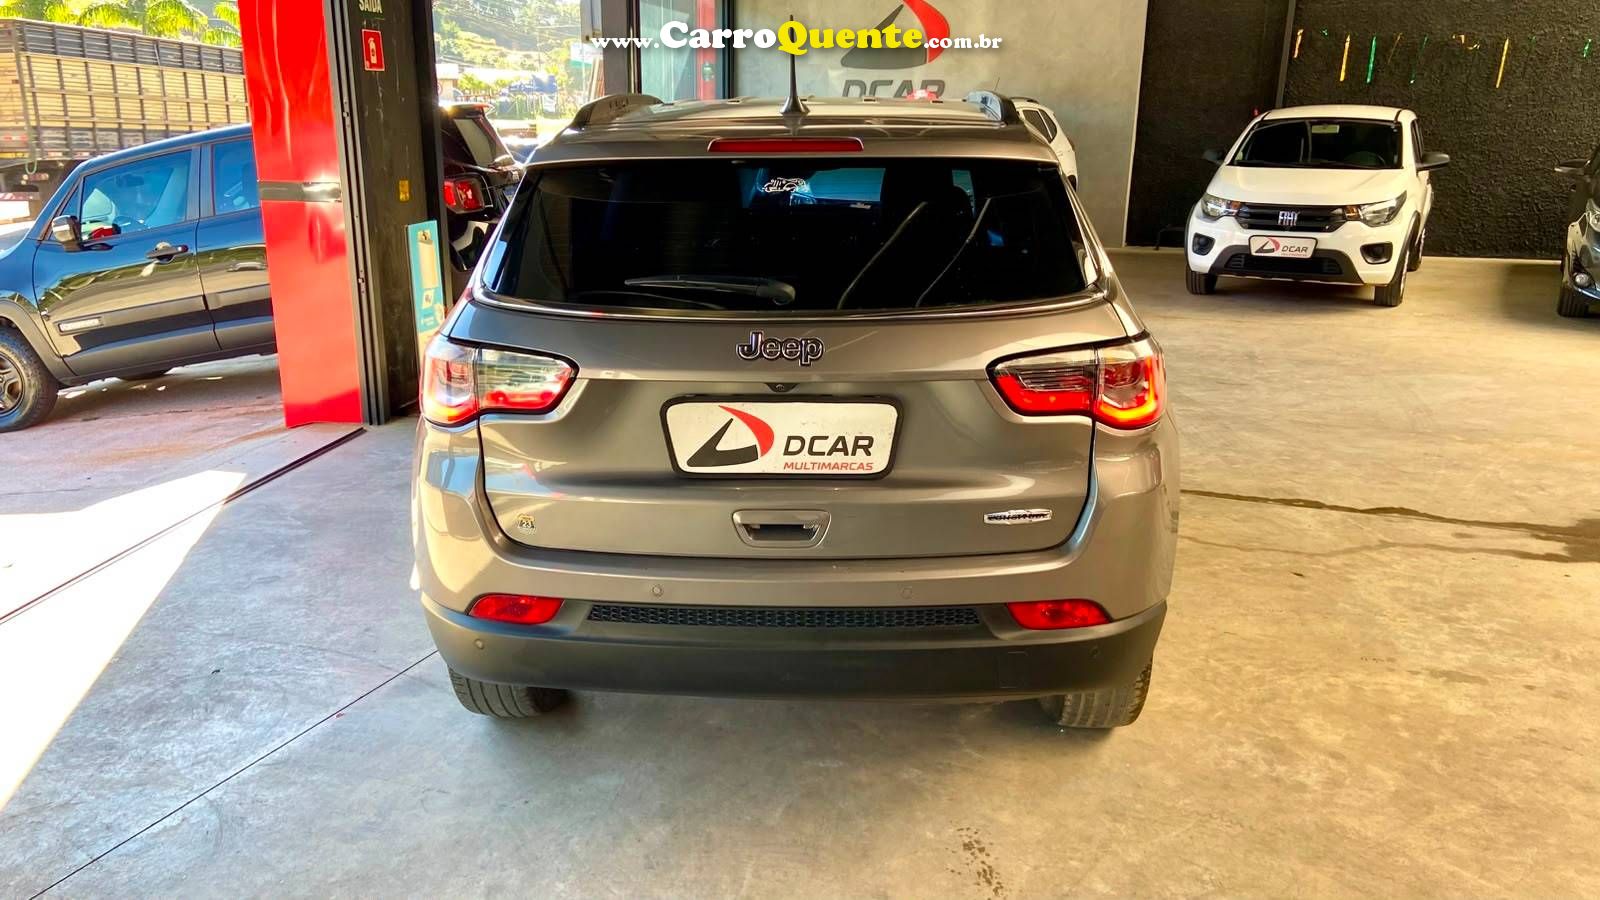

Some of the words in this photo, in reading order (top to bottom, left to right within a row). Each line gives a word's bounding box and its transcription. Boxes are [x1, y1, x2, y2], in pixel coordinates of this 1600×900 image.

[842, 79, 946, 99] DCAR
[1281, 245, 1308, 253] DCAR
[736, 331, 825, 366] Jeep
[783, 435, 874, 456] DCAR
[783, 461, 874, 471] MULTIMARCAS
